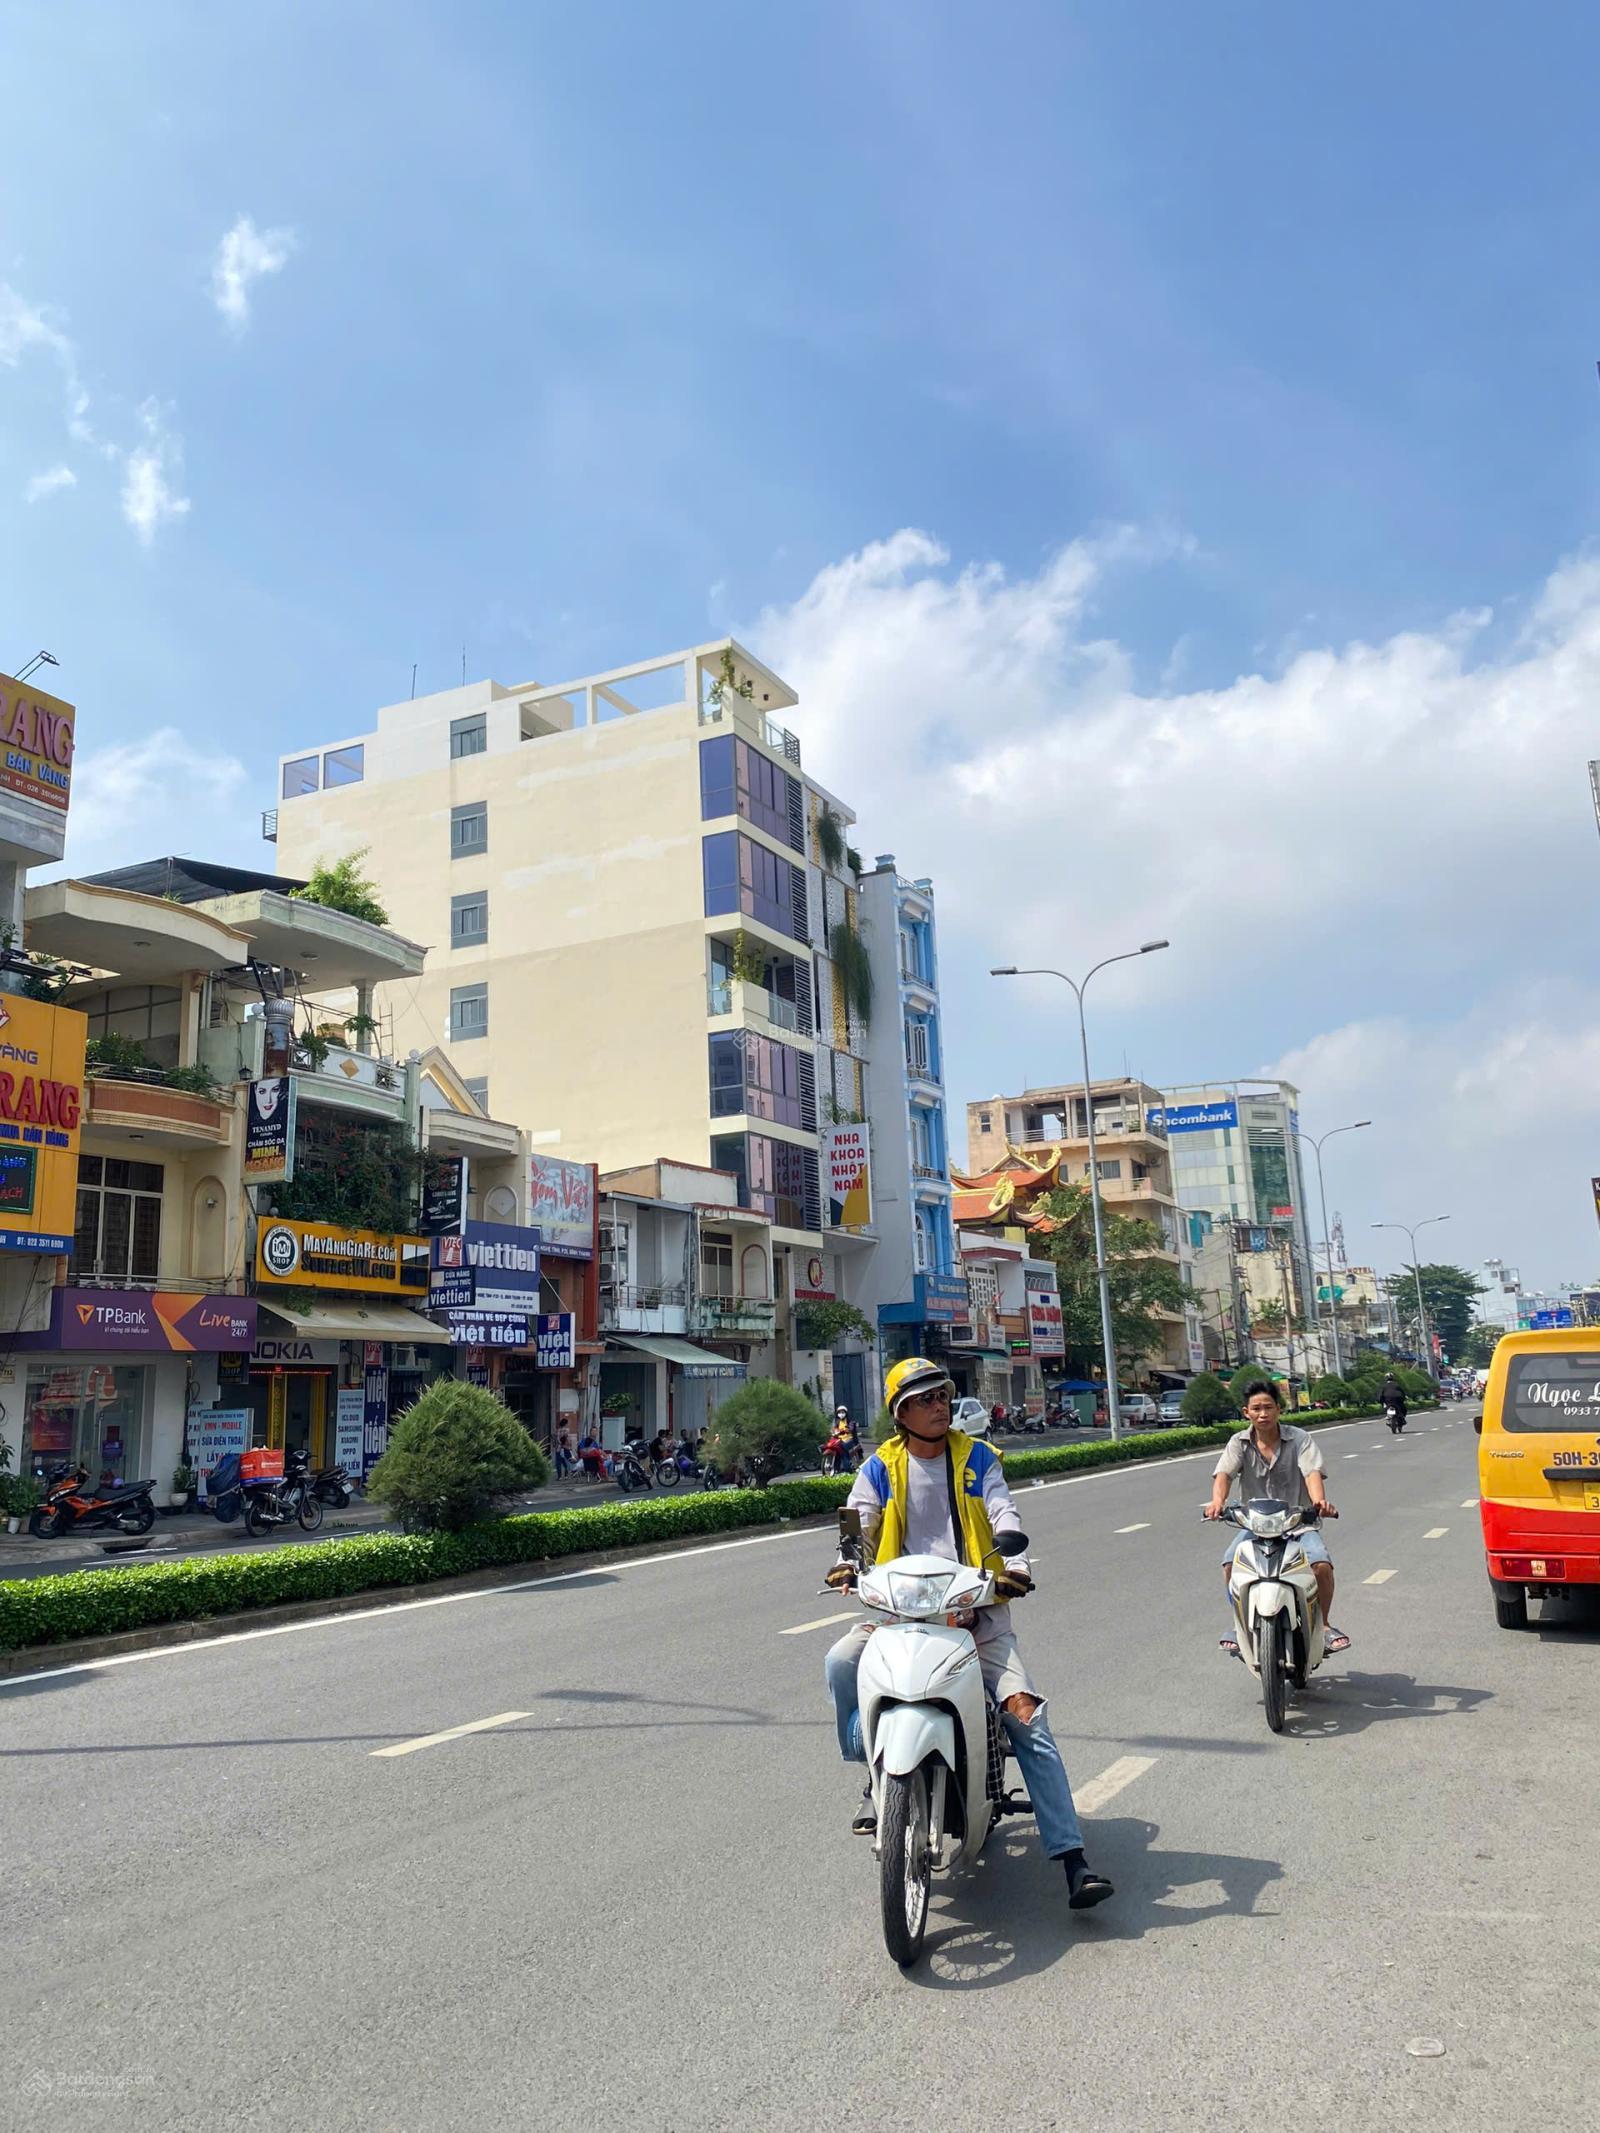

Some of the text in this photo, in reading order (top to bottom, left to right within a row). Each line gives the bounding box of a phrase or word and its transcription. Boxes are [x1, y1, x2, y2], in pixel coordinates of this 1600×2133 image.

[834, 1133, 860, 1146] NHA
[830, 1148, 864, 1161] KHOA
[831, 1161, 864, 1177] NHẬT
[834, 1178, 863, 1192] NAM
[466, 1241, 536, 1272] viettien
[430, 1289, 471, 1305] viettien
[96, 1307, 146, 1325] TPBank
[200, 1309, 248, 1327] Live BANK
[231, 1328, 248, 1337] 24/7
[491, 1324, 526, 1343] tiến
[538, 1331, 570, 1349] việt
[537, 1348, 570, 1367] tiến
[1527, 1382, 1581, 1407] Ngọc
[1563, 1406, 1590, 1416] 0933
[343, 1447, 356, 1455] OPPO
